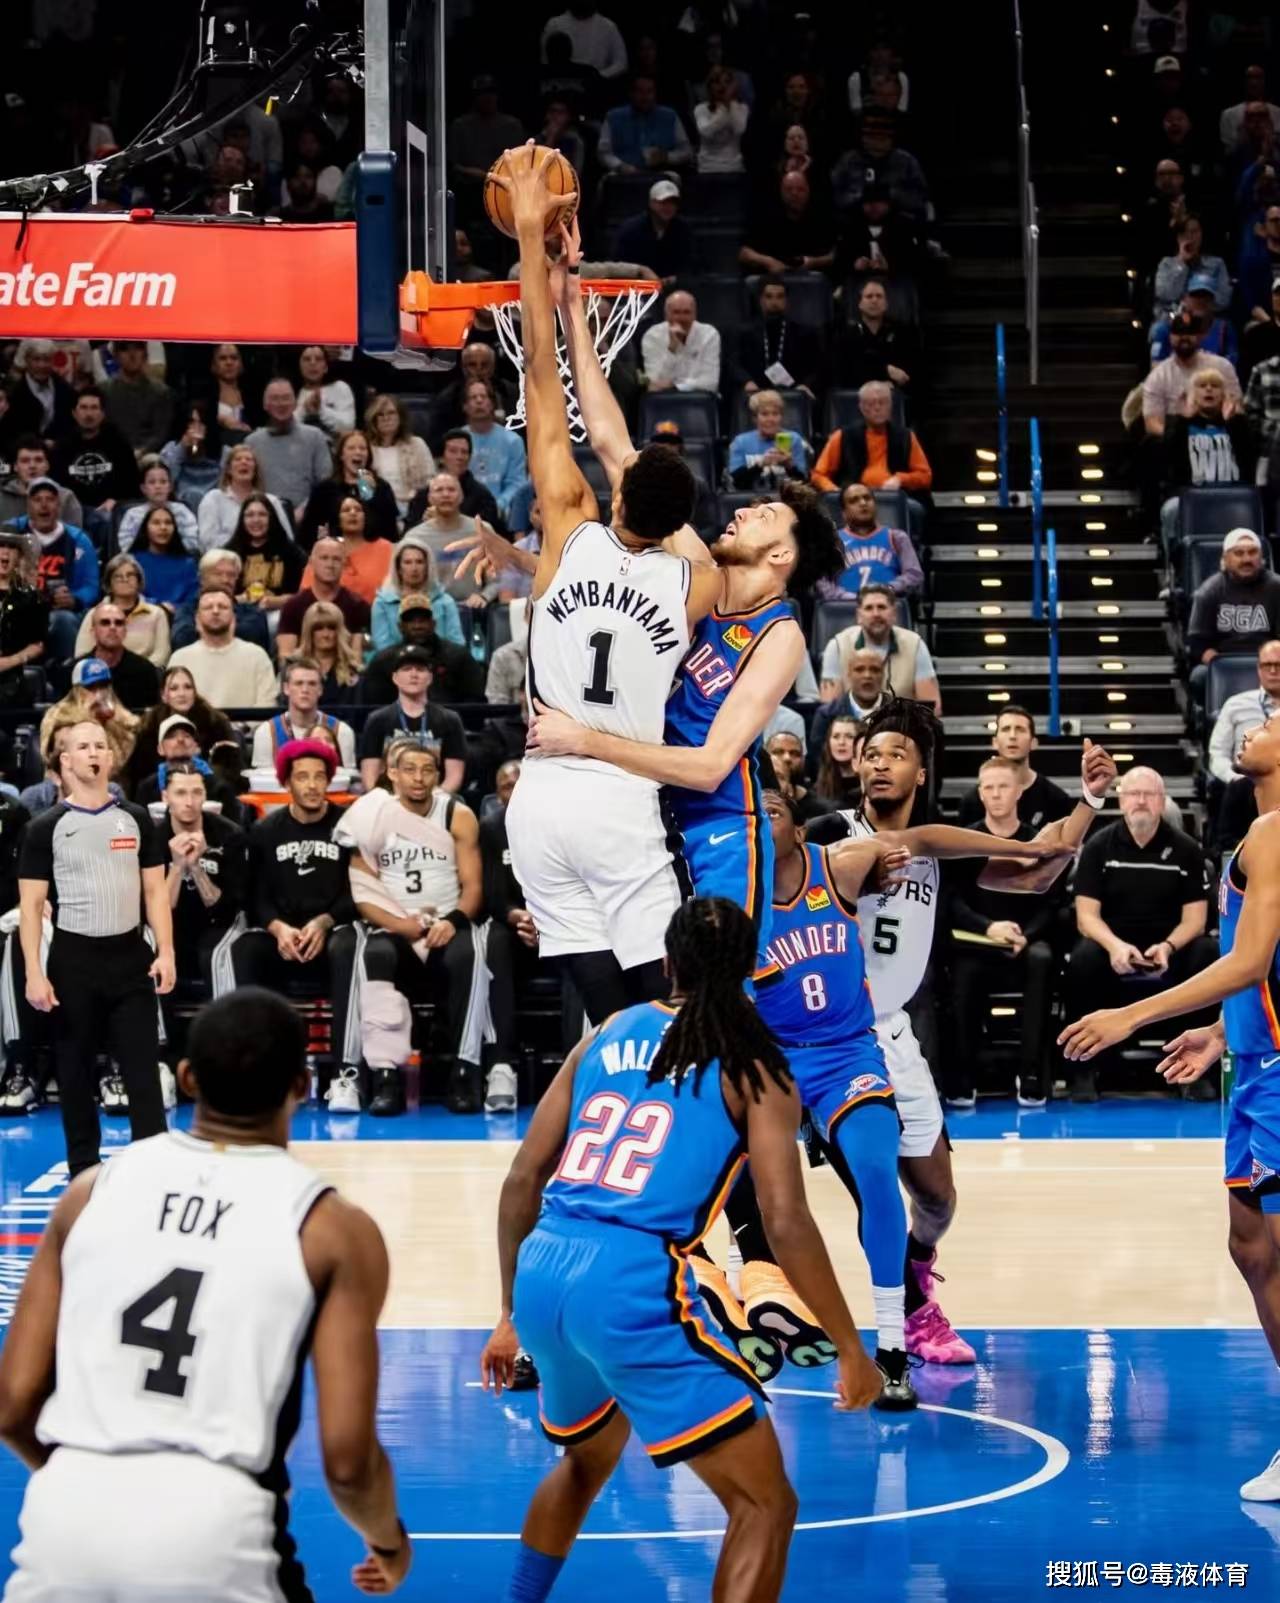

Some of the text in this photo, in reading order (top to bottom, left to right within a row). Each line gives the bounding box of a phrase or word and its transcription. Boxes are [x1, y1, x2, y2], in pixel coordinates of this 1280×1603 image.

[546, 580, 680, 657] WEMBANYAMA
[1217, 604, 1270, 632] SGA
[582, 629, 616, 708] 1
[405, 871, 423, 894] 3
[766, 923, 847, 970] HUNDER
[873, 916, 900, 955] 5
[801, 973, 827, 1012] 8
[555, 1091, 674, 1197] 22
[159, 1192, 234, 1241] FOX
[120, 1267, 205, 1400] 4
